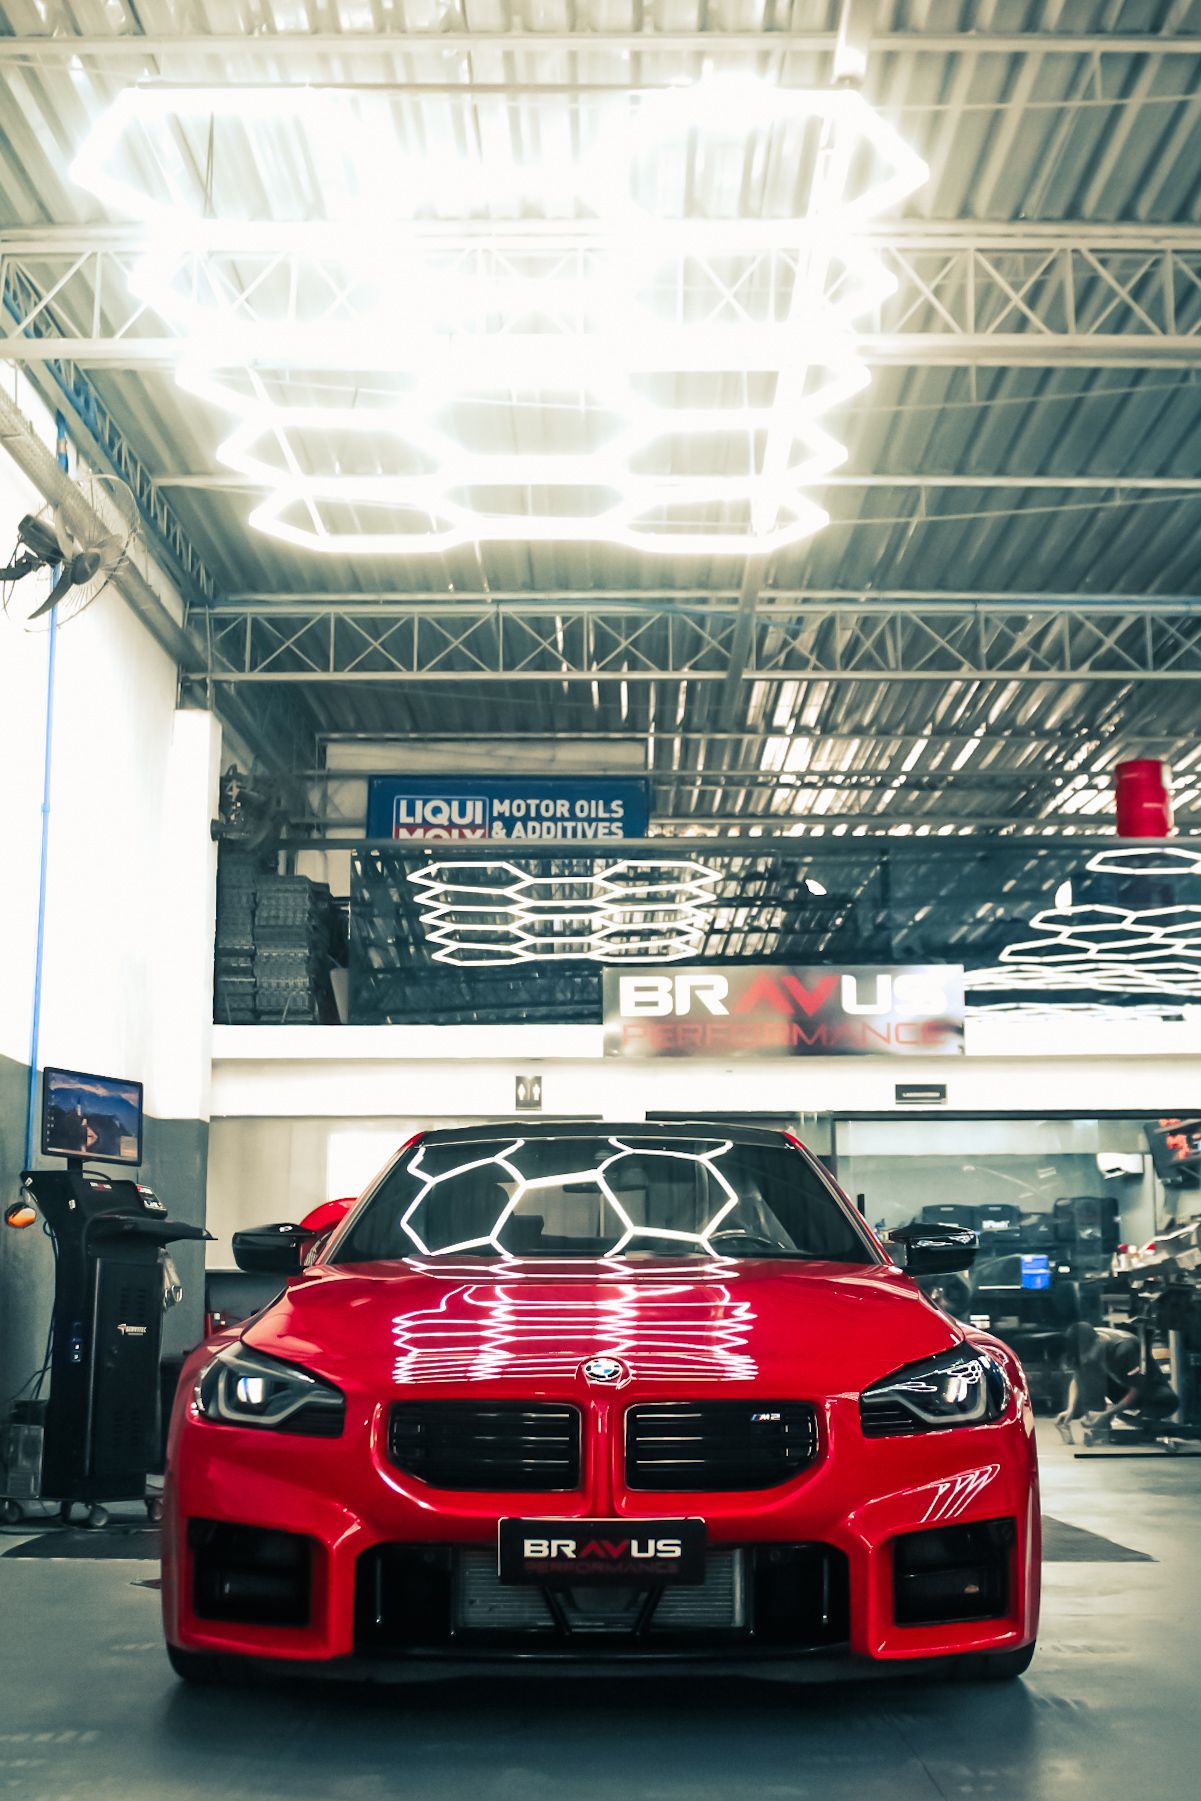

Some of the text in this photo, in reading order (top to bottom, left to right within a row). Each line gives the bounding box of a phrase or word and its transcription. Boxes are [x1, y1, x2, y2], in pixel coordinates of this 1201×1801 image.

[399, 799, 483, 826] LIQUI
[493, 799, 625, 818] MOTOR OILS
[491, 821, 507, 839] &
[511, 822, 624, 839] ADDITIVES
[619, 974, 948, 1017] BRAVUS
[523, 1539, 682, 1558] BRAVUS
